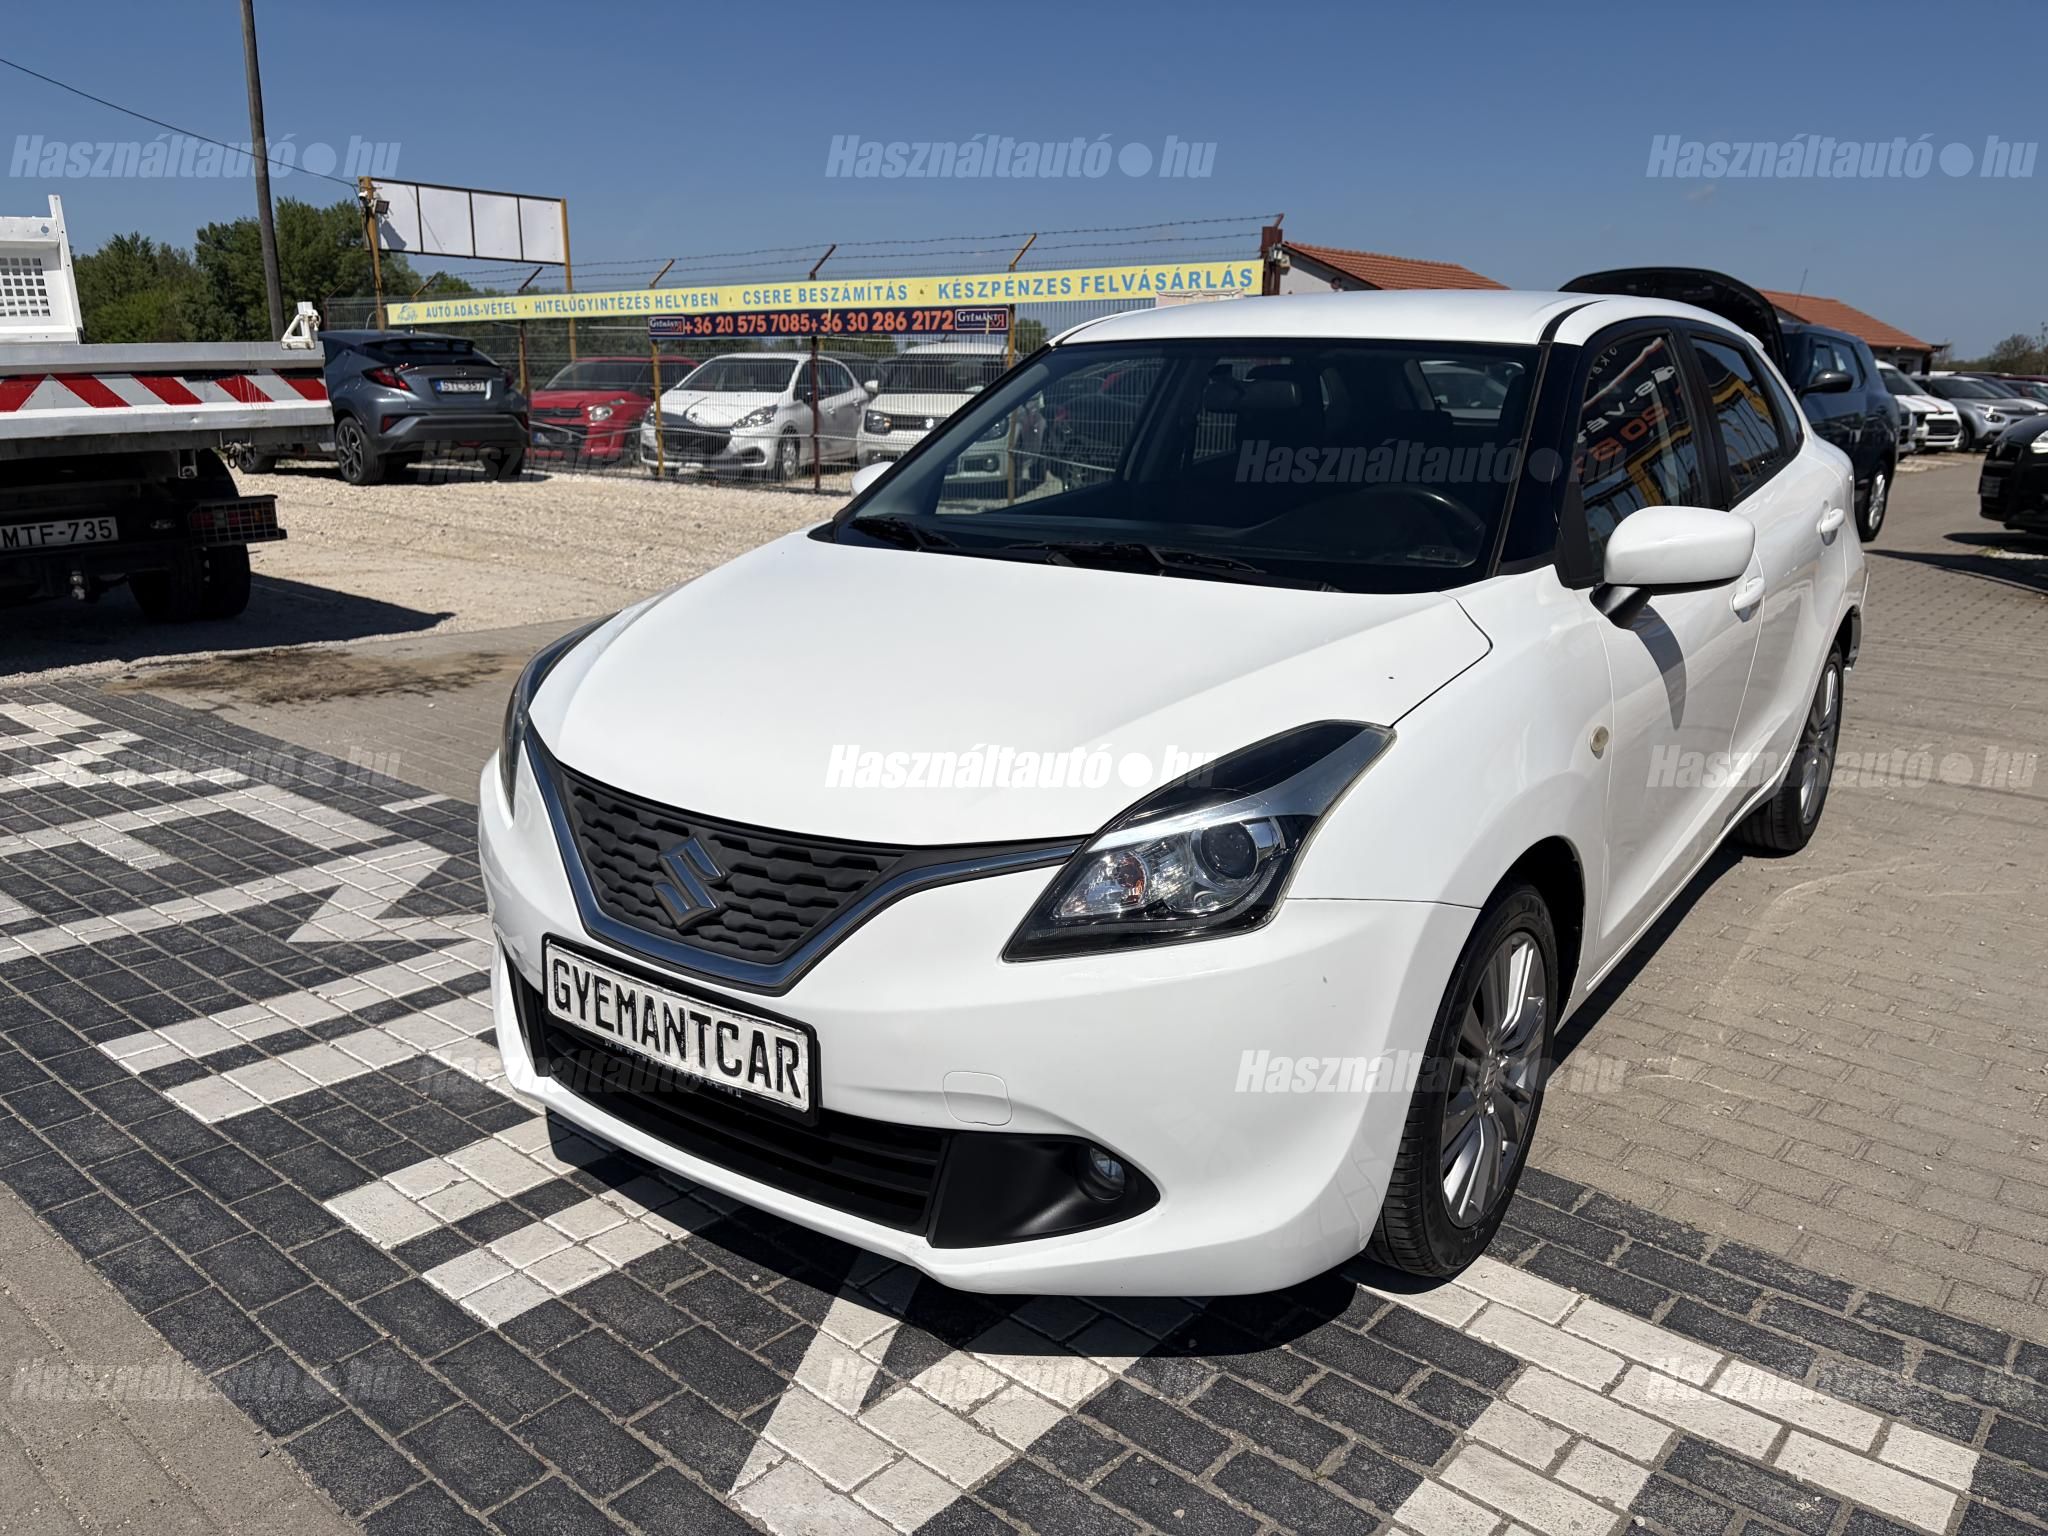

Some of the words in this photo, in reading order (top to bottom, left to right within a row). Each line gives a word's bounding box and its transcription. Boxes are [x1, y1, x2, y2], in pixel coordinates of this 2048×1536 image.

[426, 302, 451, 318] AUTÓ
[454, 299, 517, 317] ADÁS-VÉTEL
[655, 293, 719, 309] HELYBEN
[743, 288, 792, 305] CSERE
[799, 282, 908, 303] BESZÁMÍTÁS
[938, 276, 1071, 300] KÉSZPÉNZES
[1080, 265, 1253, 293] FELVÁSÁRLÁS
[684, 316, 713, 335] +36
[716, 315, 734, 334] 20
[737, 314, 767, 333] 575
[769, 313, 810, 333] 7085
[847, 311, 866, 331] 30
[872, 311, 908, 331] 286
[912, 310, 954, 331] 2172
[1, 519, 113, 549] MTF-735
[552, 957, 802, 1100] GYEMANTCAR
